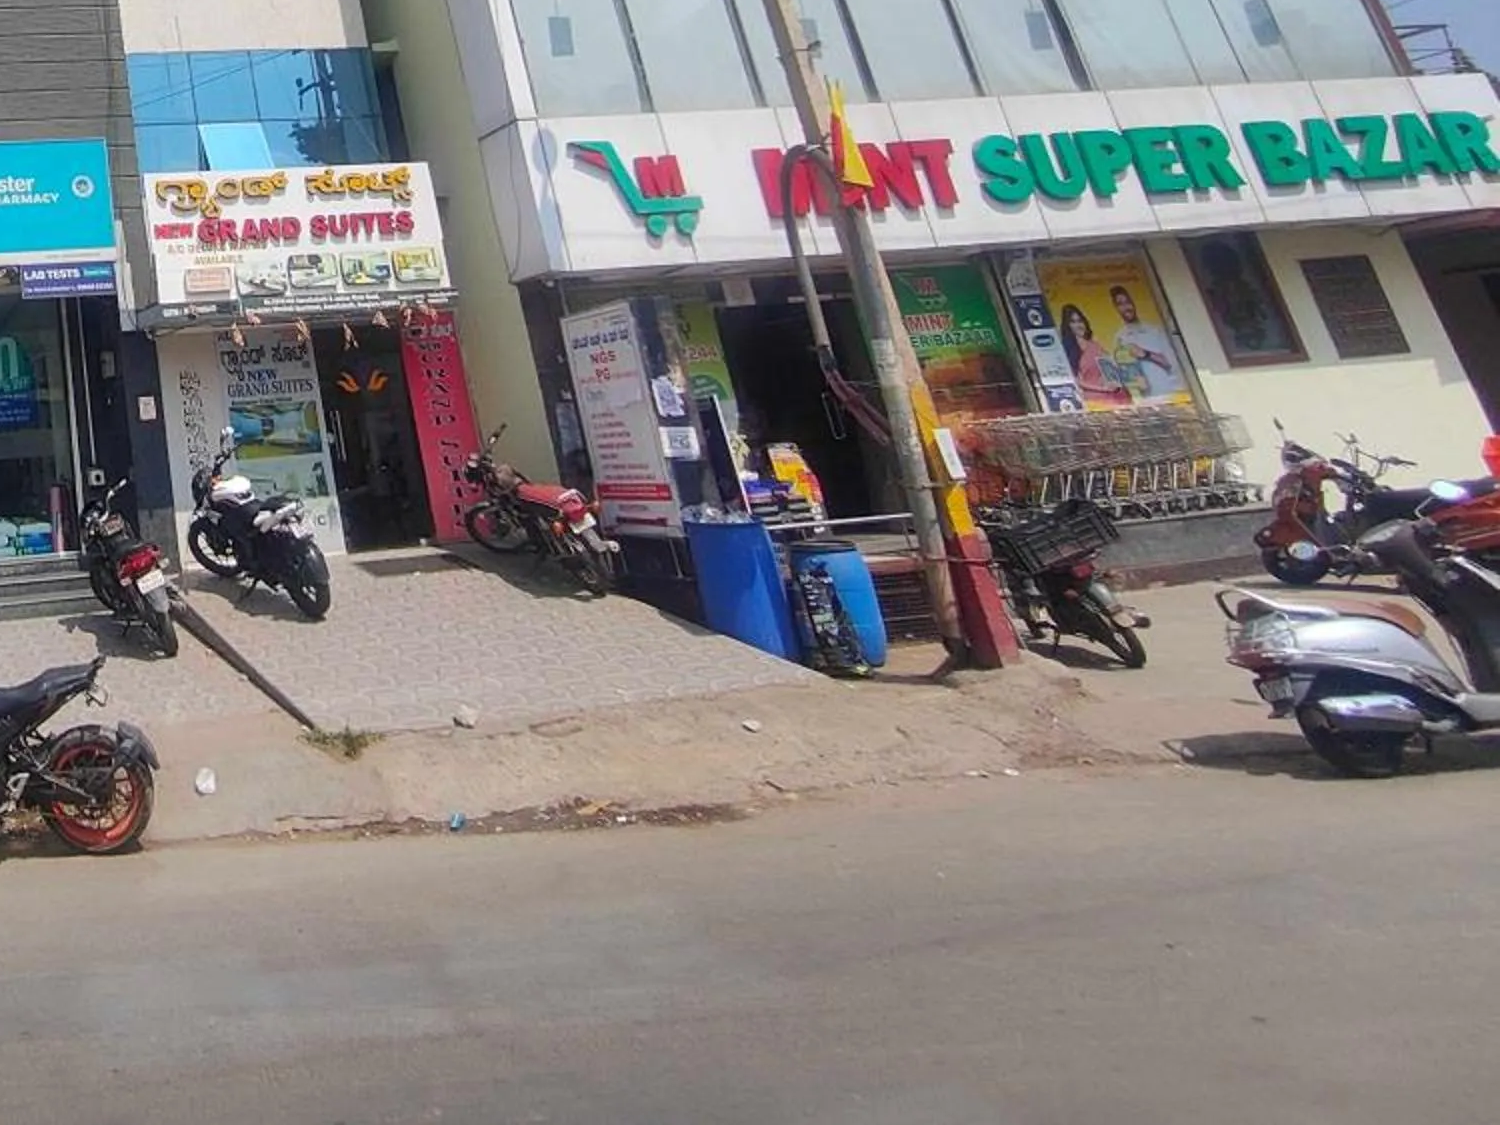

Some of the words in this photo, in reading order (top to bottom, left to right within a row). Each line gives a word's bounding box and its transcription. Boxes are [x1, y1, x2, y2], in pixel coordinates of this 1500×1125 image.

[972, 123, 1247, 203] SUPER
[1240, 110, 1500, 187] BAZAR
[633, 154, 686, 198] M
[197, 216, 302, 243] GRAND
[310, 210, 415, 239] SUITES
[227, 382, 269, 398] GRAND
[271, 378, 315, 394] SUITES
